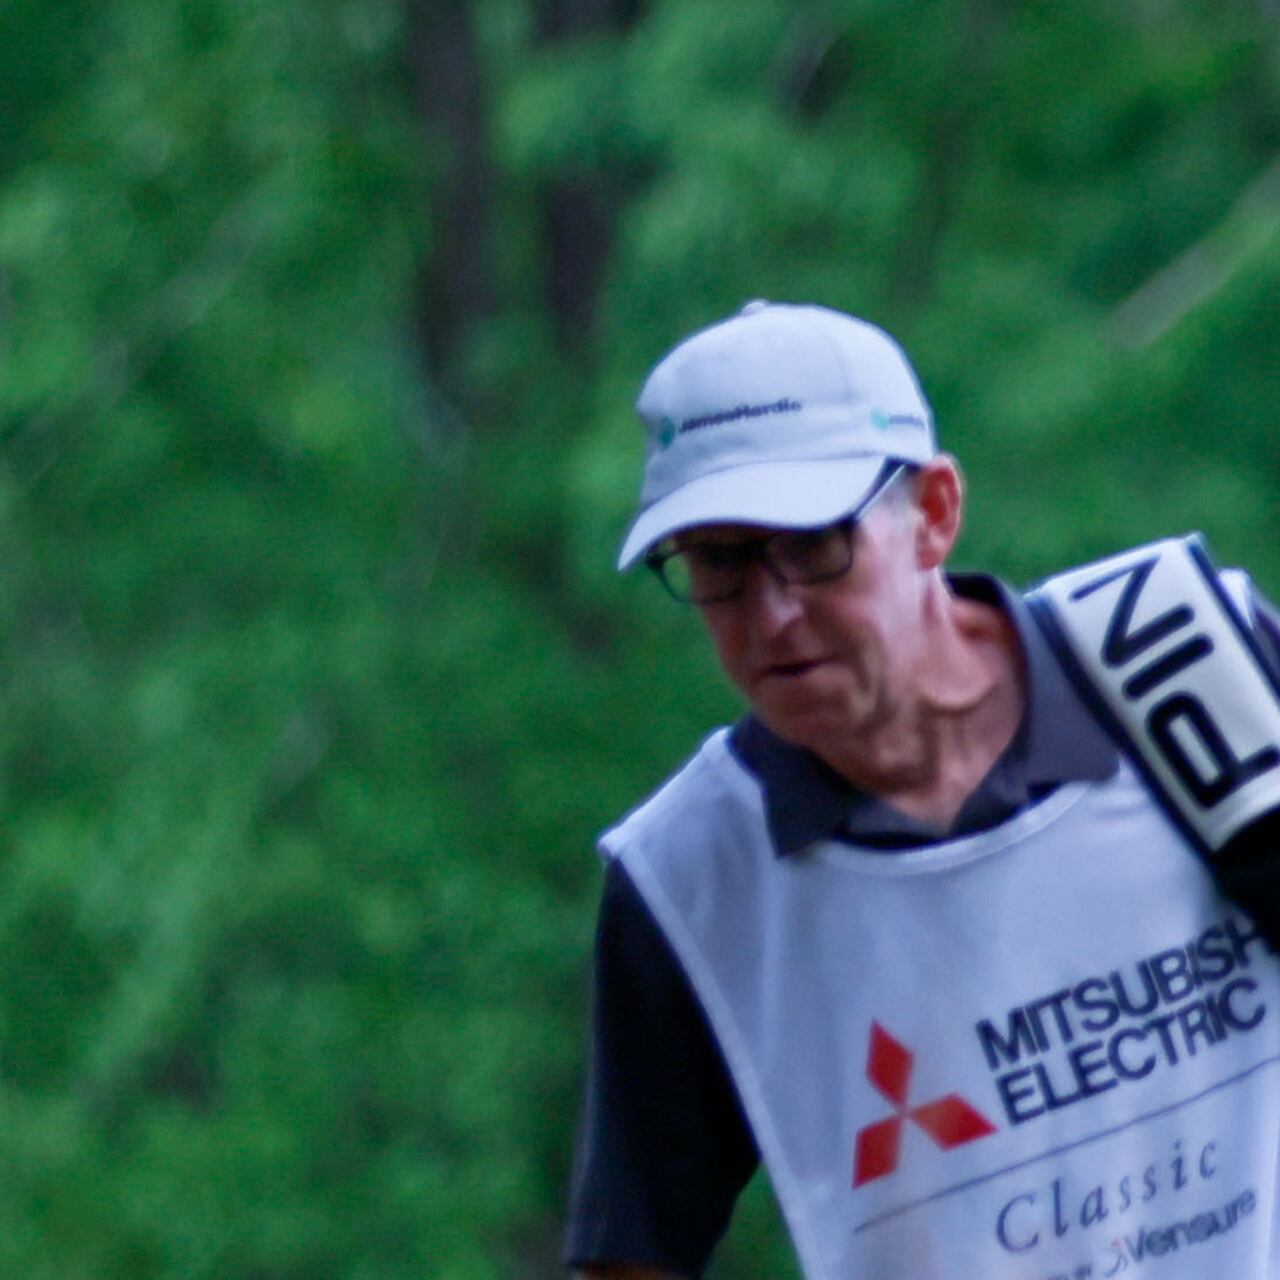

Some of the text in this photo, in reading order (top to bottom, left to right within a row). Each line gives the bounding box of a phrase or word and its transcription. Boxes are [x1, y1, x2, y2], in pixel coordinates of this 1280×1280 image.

[995, 978, 1267, 1127] ELECTRIC
[995, 1138, 1219, 1254] Classic
[1123, 1188, 1257, 1263] Vensure
